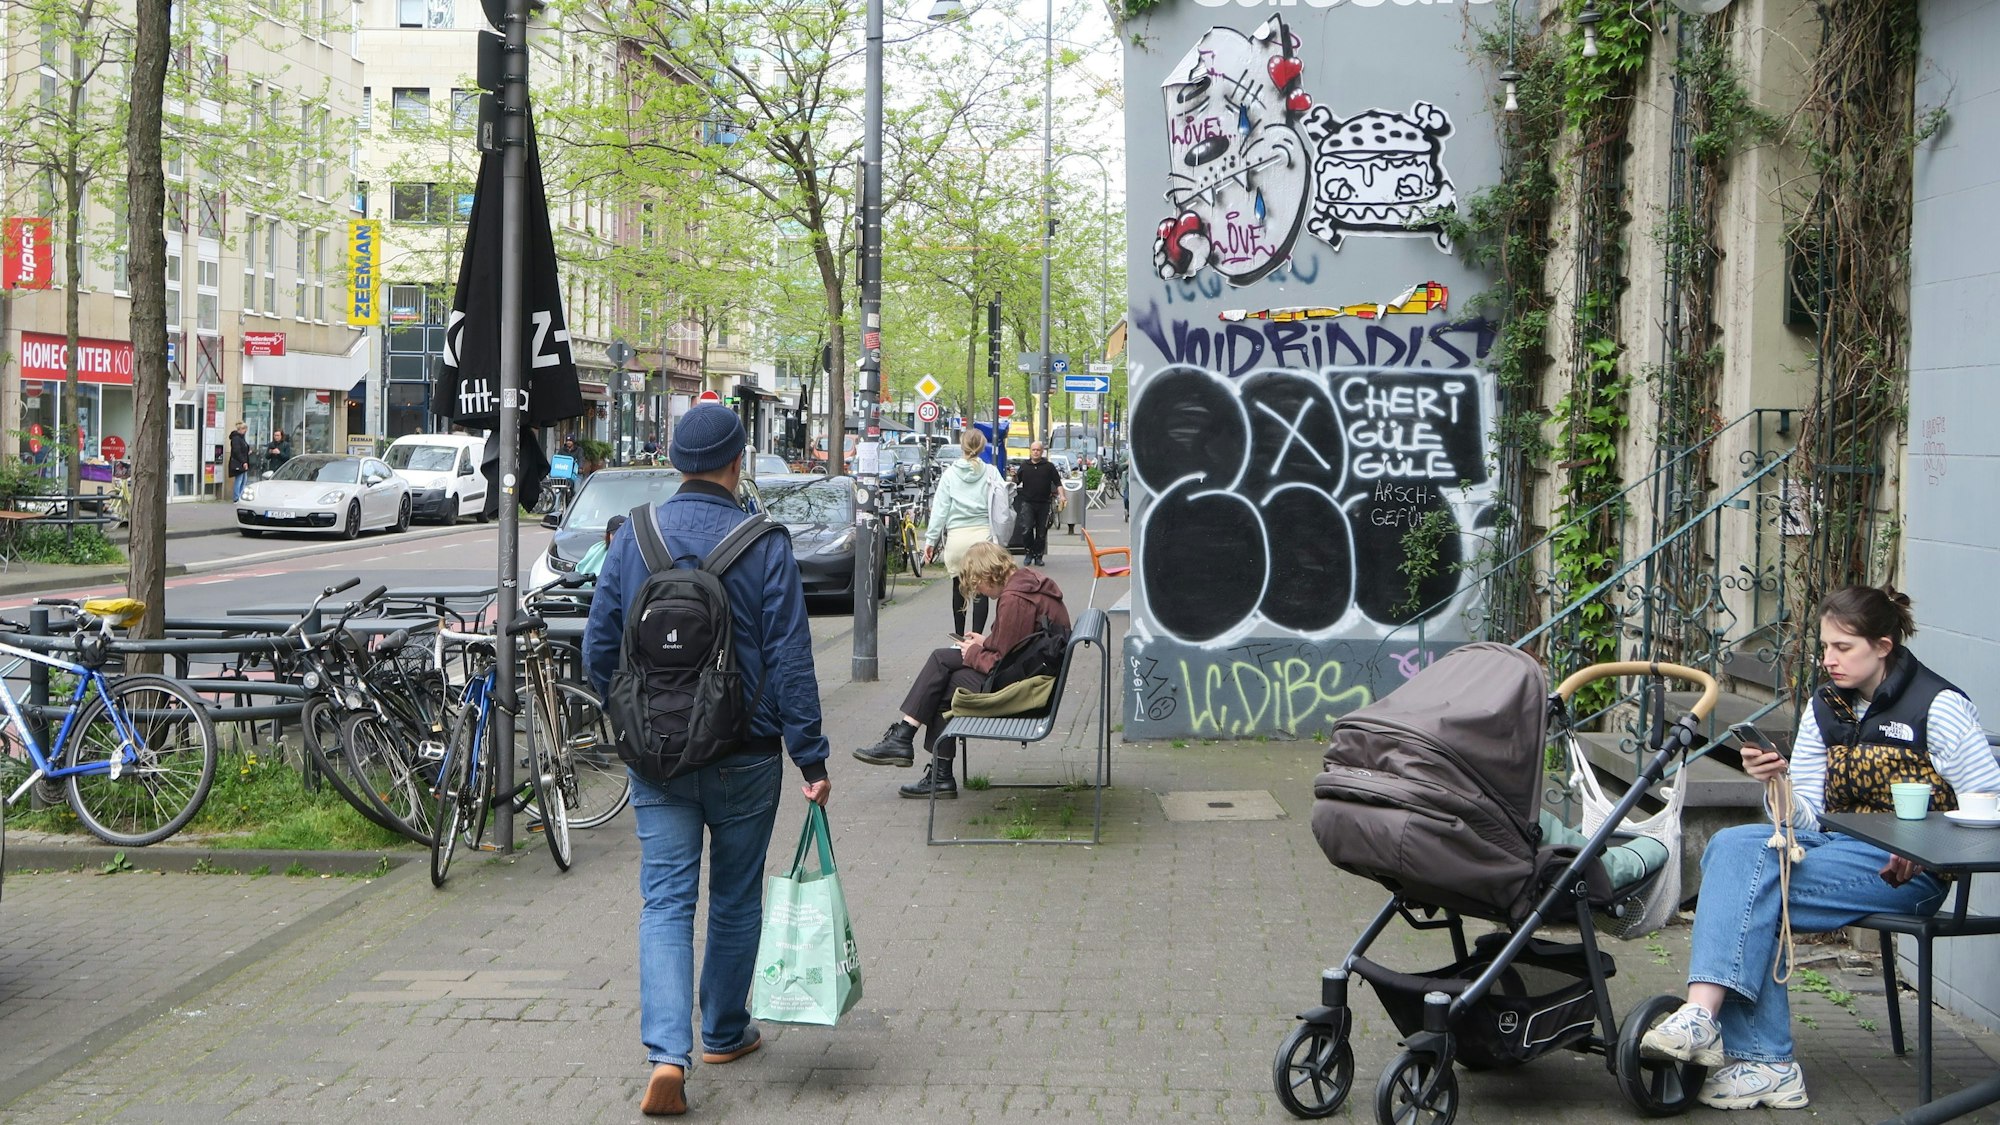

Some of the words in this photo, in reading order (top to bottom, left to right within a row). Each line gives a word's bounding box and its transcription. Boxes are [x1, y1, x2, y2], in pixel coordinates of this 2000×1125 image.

[18, 224, 37, 282] tipico
[355, 225, 372, 318] ZEEMAN
[22, 341, 111, 372] HOMECNTER
[114, 346, 133, 374] KÖ
[922, 406, 934, 416] 30
[1348, 420, 1443, 451] GÜLE
[1353, 451, 1457, 479] GÜLE
[1879, 725, 1904, 735] NORTH
[1885, 730, 1904, 740] FACE
[1890, 721, 1904, 729] THE
